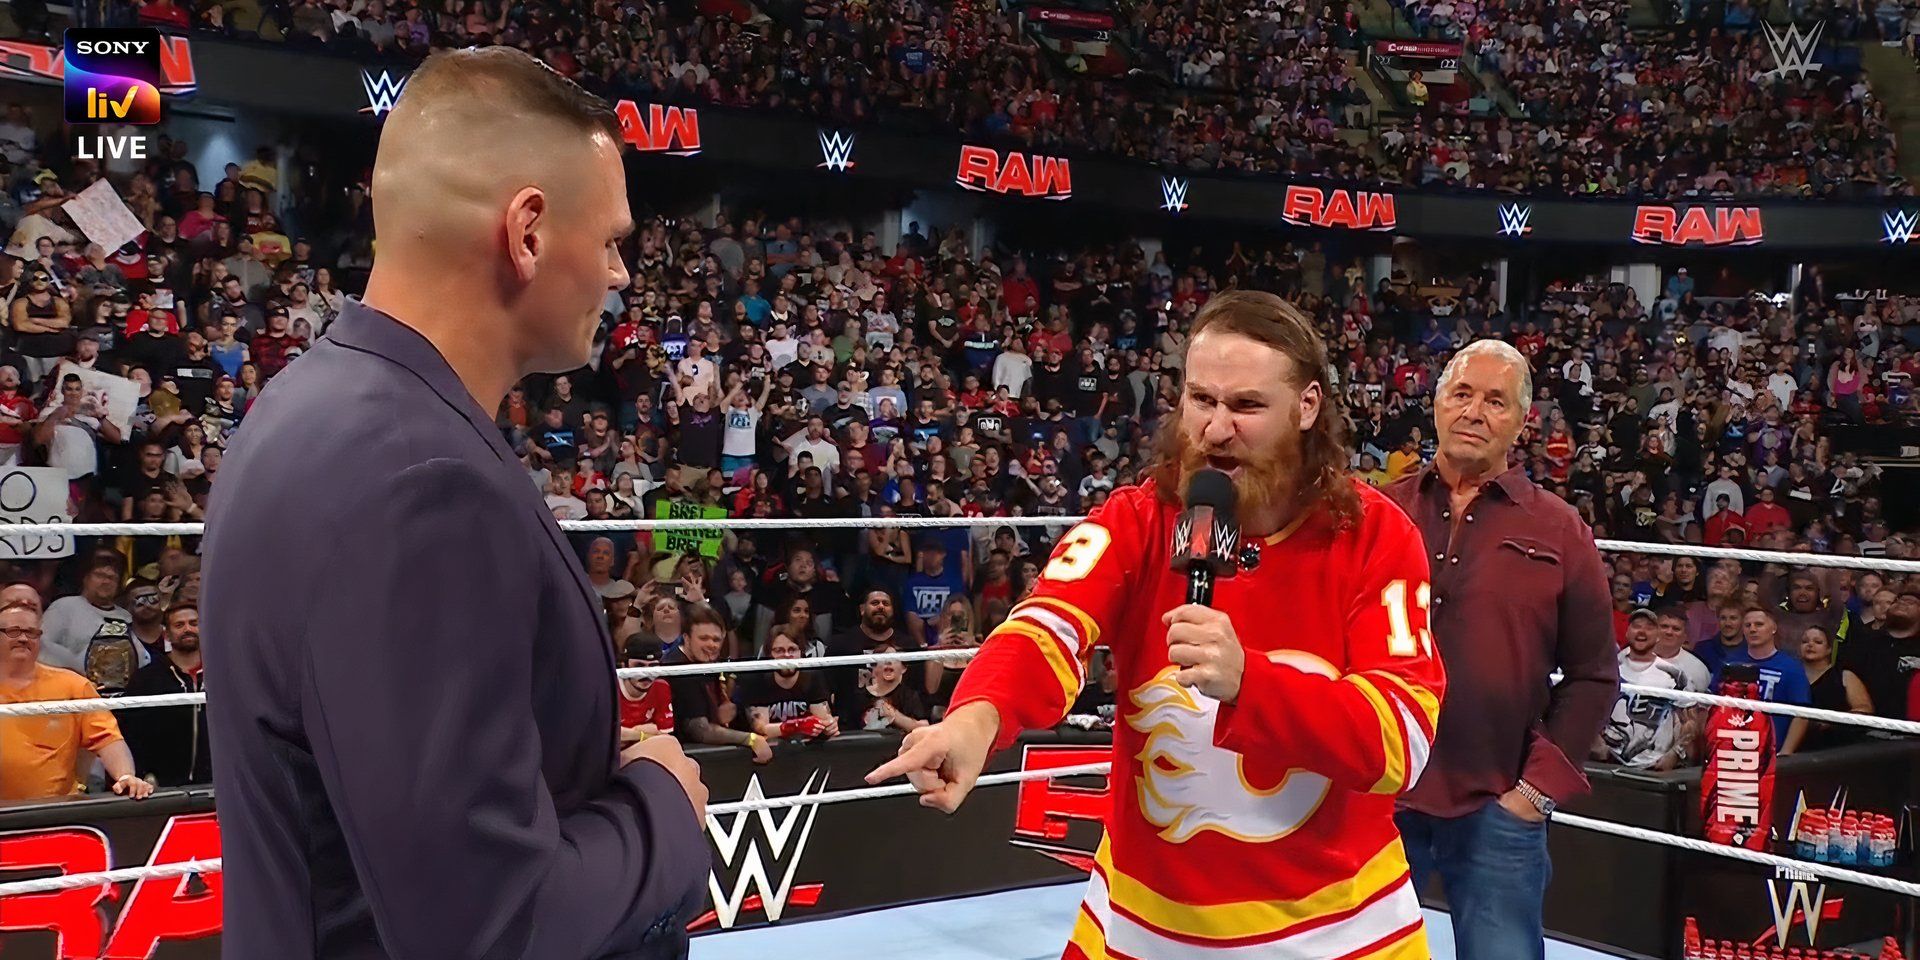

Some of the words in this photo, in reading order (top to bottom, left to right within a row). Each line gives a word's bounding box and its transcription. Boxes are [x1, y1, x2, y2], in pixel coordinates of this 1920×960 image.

[957, 144, 1073, 197] RAW
[1283, 184, 1397, 230] RAW
[1632, 204, 1764, 245] RAW
[1717, 729, 1759, 826] PRIME
